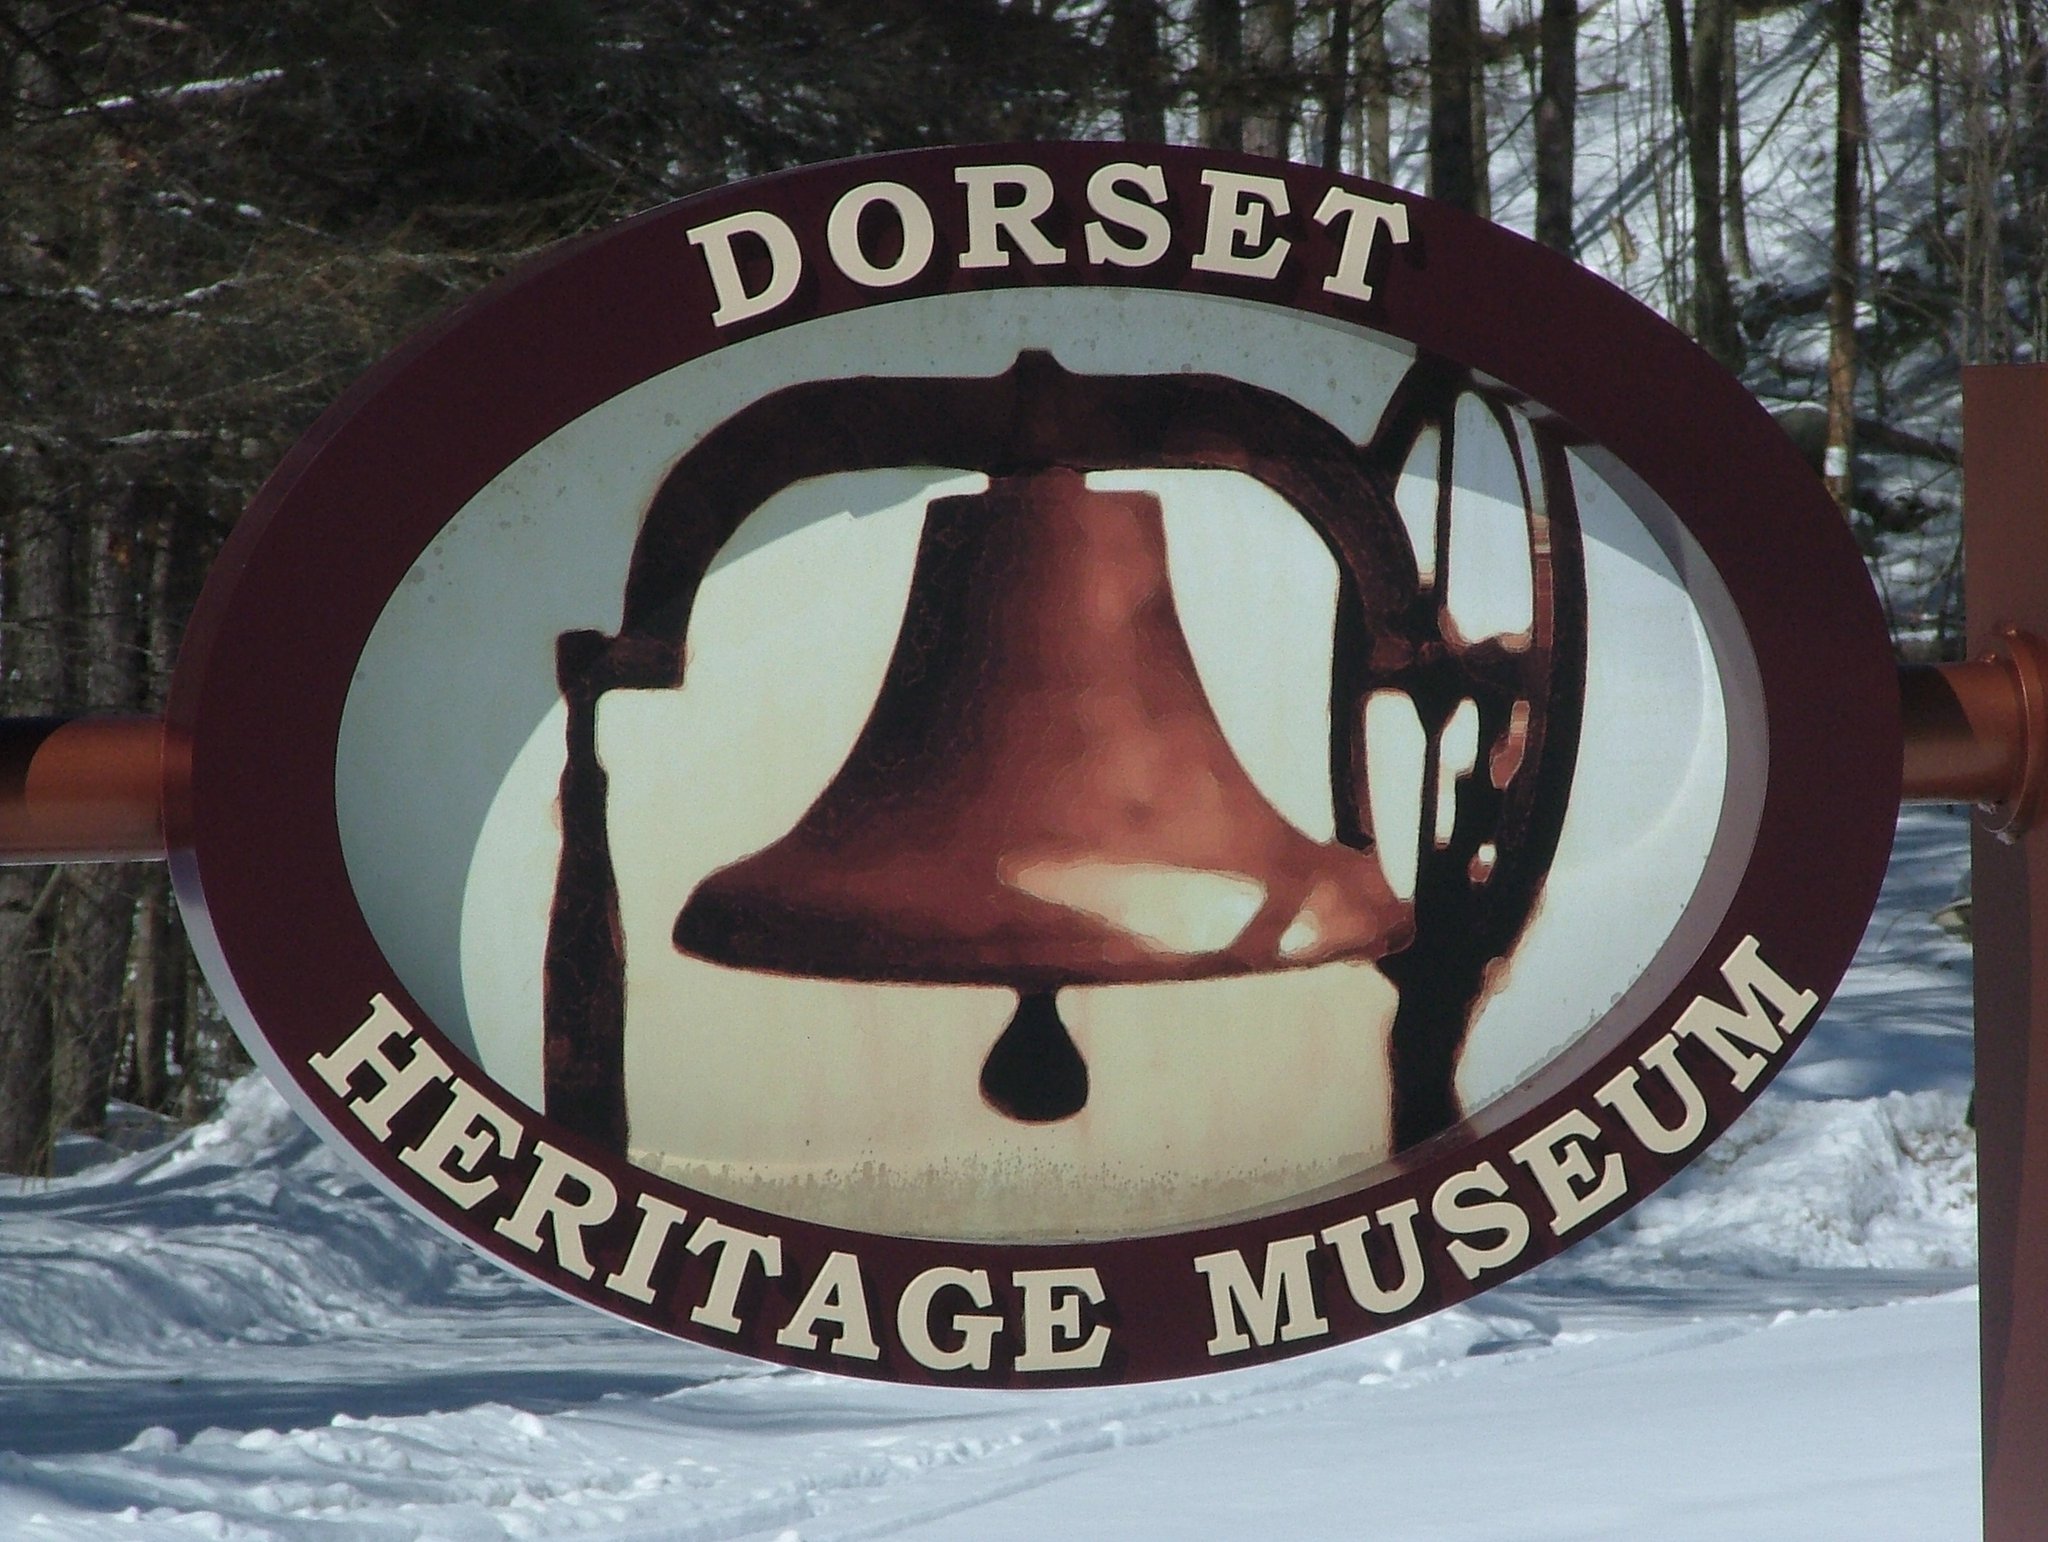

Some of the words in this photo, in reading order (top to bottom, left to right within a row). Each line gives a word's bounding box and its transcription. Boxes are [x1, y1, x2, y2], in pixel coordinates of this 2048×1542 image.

[686, 162, 1411, 328] DORSET
[308, 992, 1112, 1374] HERITAGE
[1193, 934, 1819, 1357] MUSEUM
